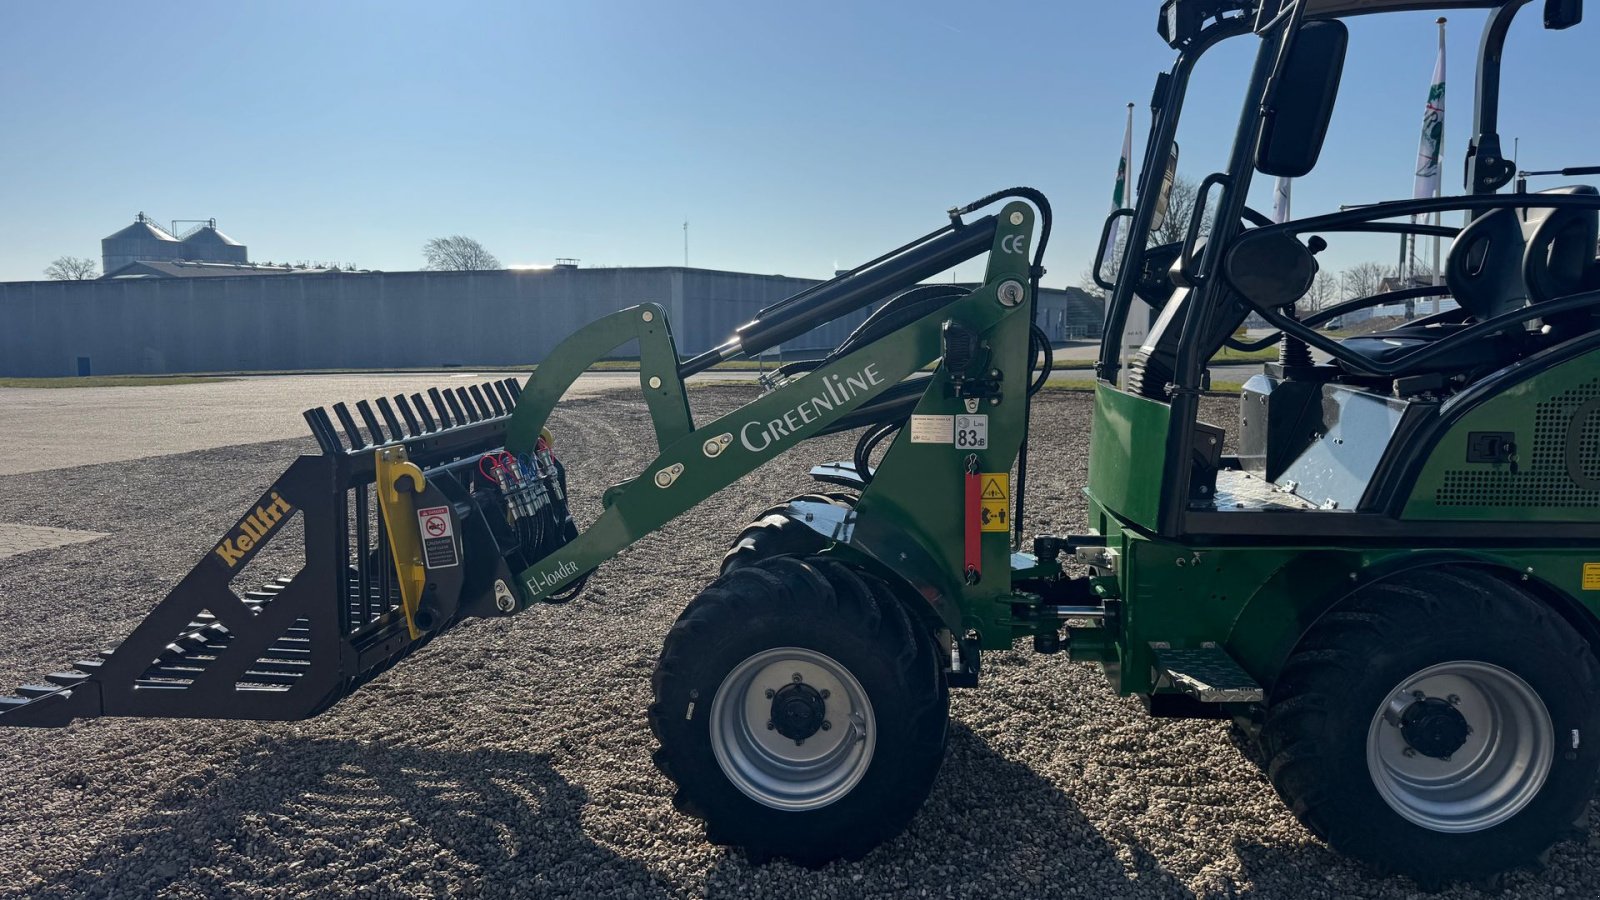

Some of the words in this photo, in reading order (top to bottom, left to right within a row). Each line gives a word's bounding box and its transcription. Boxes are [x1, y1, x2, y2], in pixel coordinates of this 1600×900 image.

[1001, 234, 1025, 254] CE
[958, 429, 977, 447] 83
[215, 491, 291, 567] Kellfri
